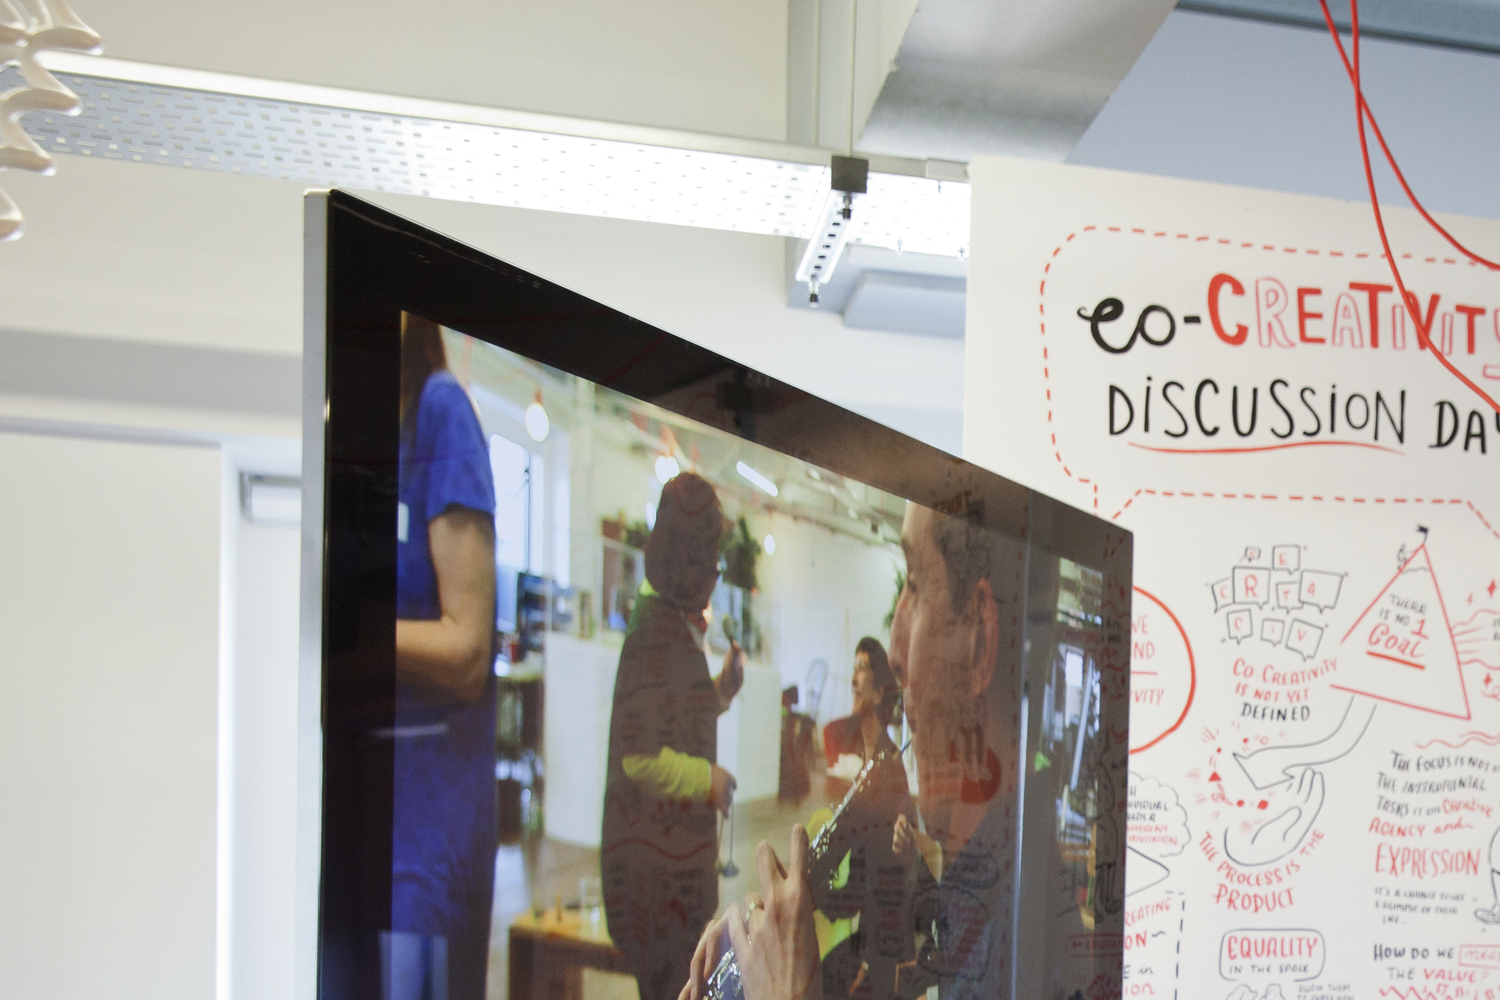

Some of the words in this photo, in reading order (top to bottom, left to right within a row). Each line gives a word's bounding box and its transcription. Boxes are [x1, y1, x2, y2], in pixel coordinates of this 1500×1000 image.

[1389, 593, 1428, 614] THERE
[1379, 608, 1389, 620] IS
[1394, 614, 1411, 626] NO
[1235, 682, 1247, 697] IS
[1253, 689, 1280, 703] NOT
[1287, 688, 1310, 705] YET
[1241, 702, 1311, 722] DEFINED
[1417, 755, 1451, 773] FOCUS
[1377, 770, 1398, 793] THE
[1368, 817, 1427, 838] AGENCY
[1199, 830, 1219, 862] THE
[1217, 861, 1283, 887] PROCESS
[1286, 861, 1301, 876] IS
[1299, 828, 1325, 856] THE
[1375, 843, 1481, 879] EXPRESSION
[1212, 884, 1296, 914] PRODUCT
[1228, 935, 1318, 960] EQUALITY
[1374, 944, 1406, 962] HOW
[1411, 947, 1429, 960] DO
[1437, 947, 1455, 960] WE
[1229, 964, 1243, 974] IN
[1251, 964, 1272, 974] THE
[1279, 964, 1309, 974] SPACE
[1387, 967, 1416, 981] THE
